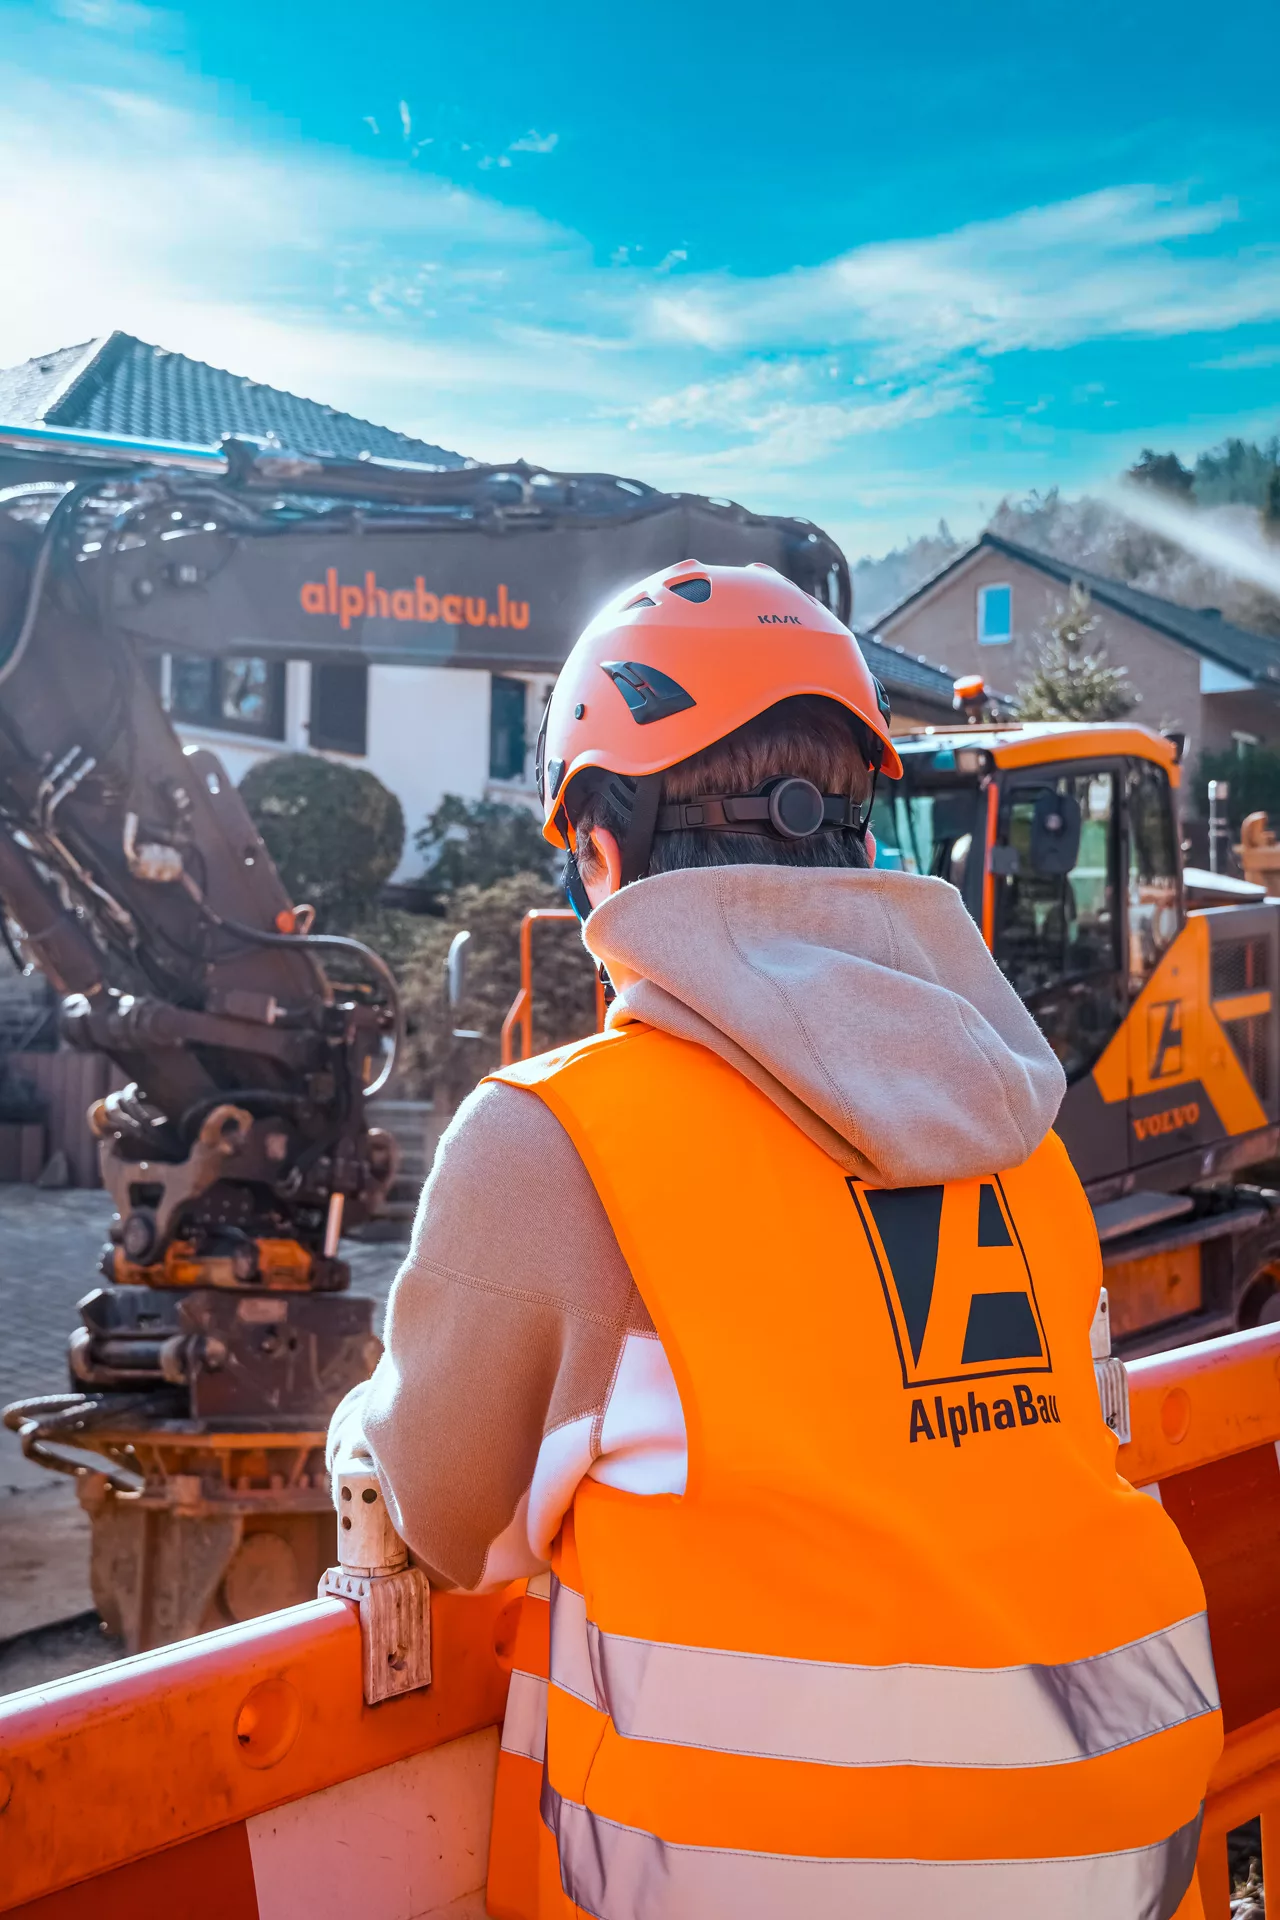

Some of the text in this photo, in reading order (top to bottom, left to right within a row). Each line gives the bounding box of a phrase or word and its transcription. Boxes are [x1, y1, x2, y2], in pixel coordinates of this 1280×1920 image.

[300, 567, 530, 629] alphabau.lu
[1133, 1102, 1199, 1141] VOLVO
[909, 1384, 1061, 1448] AlphaBau
